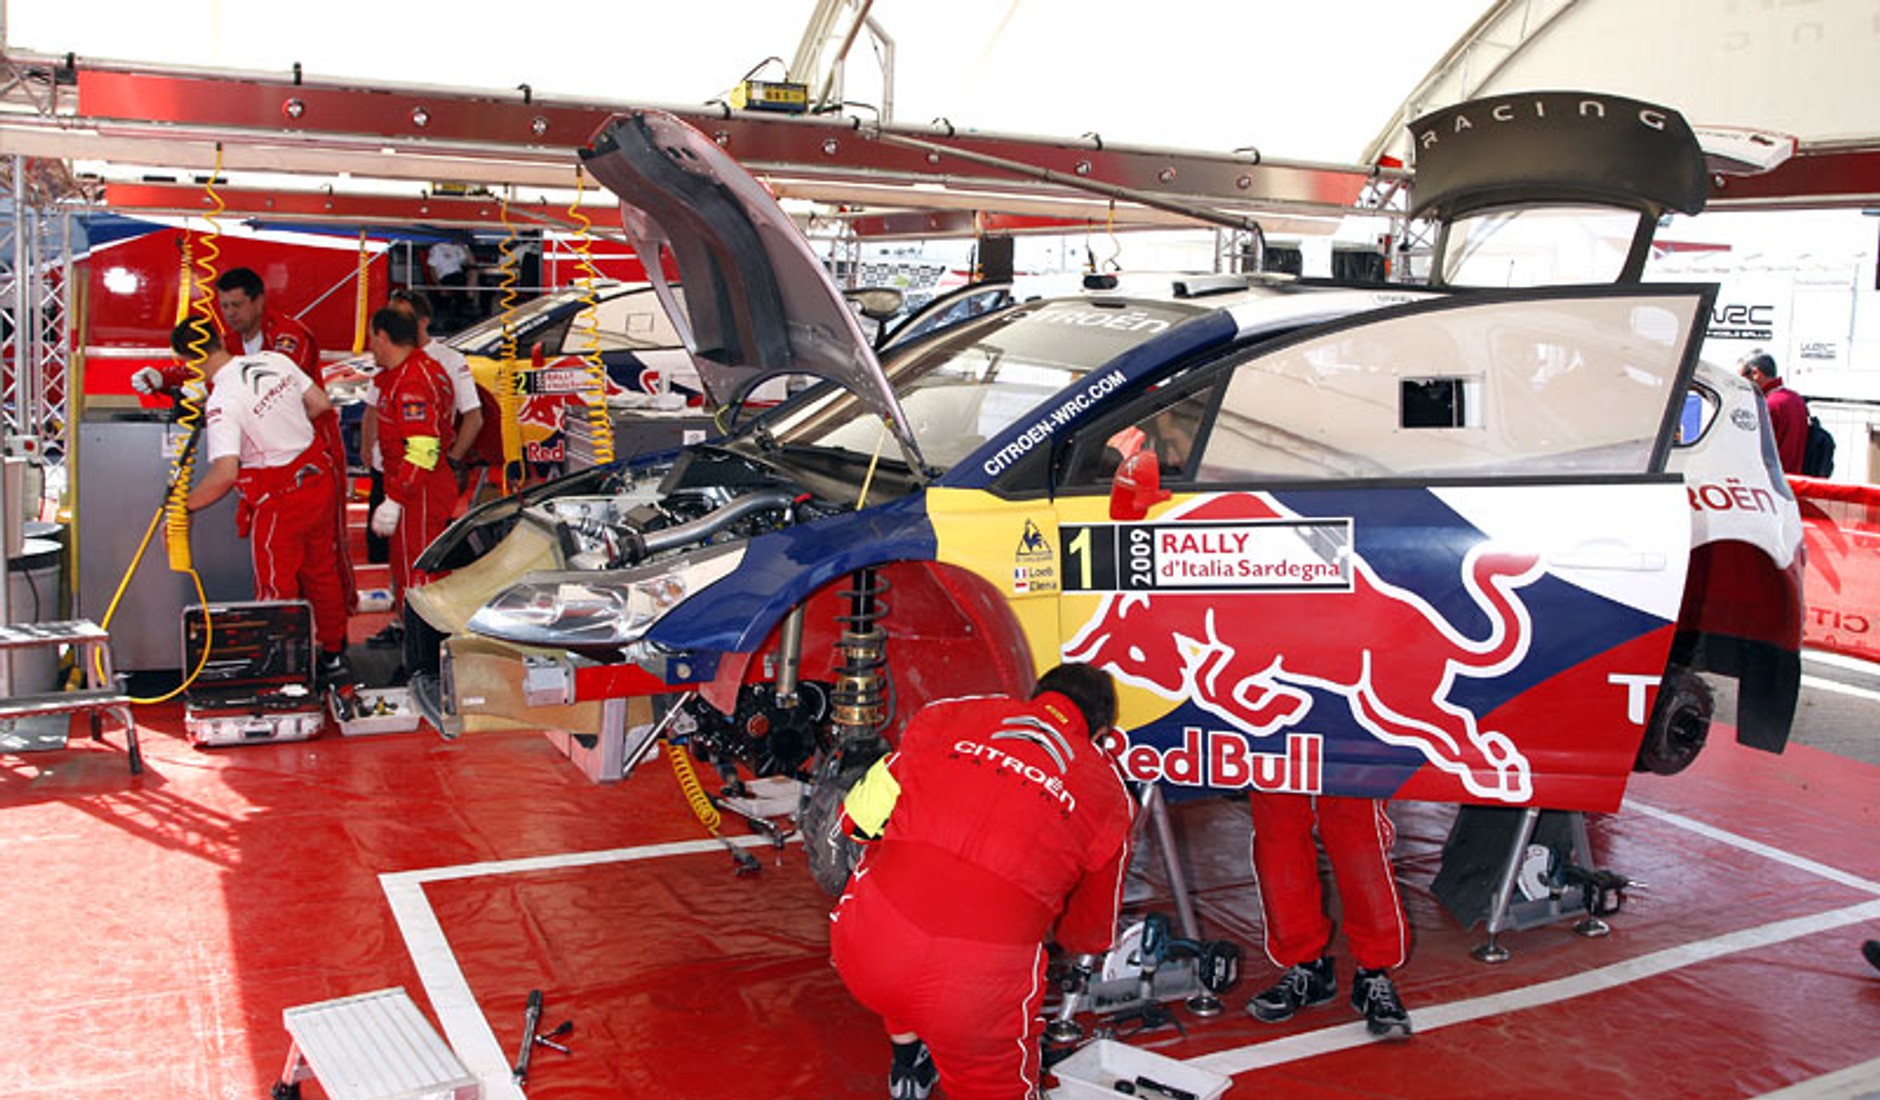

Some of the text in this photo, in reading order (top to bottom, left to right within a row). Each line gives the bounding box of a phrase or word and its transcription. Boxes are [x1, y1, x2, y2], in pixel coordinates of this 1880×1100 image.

[1420, 100, 1668, 150] RACING
[517, 373, 528, 394] 2
[983, 370, 1127, 476] CITROEN-WRC.COM
[527, 441, 564, 461] Red
[1069, 527, 1092, 589] 1
[1131, 528, 1151, 586] 2009
[1161, 533, 1249, 553] RALLY
[1161, 559, 1340, 581] d'Italia Sardegna
[1103, 727, 1203, 786] Red
[1208, 731, 1322, 794] Bull
